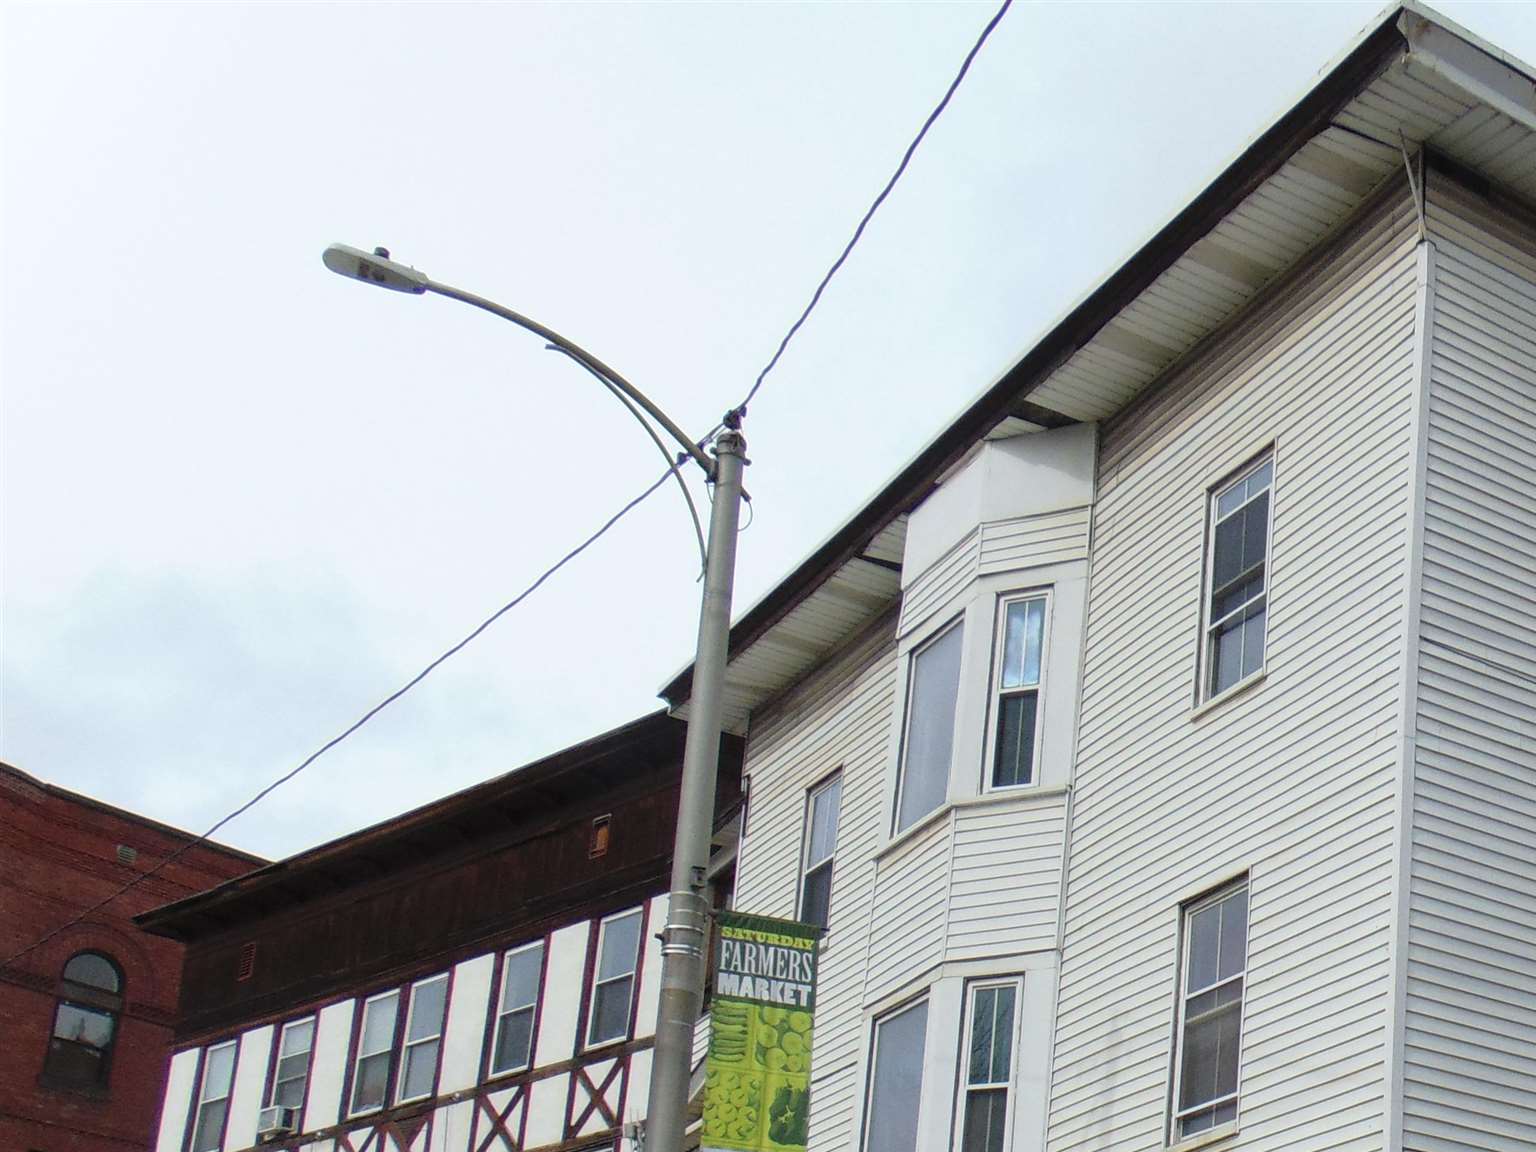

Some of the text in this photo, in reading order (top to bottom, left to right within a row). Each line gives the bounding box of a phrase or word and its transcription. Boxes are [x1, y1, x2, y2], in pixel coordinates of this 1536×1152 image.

[721, 926, 815, 950] SATURDAY
[719, 939, 813, 983] FARMERS
[717, 972, 812, 1008] MARKET
